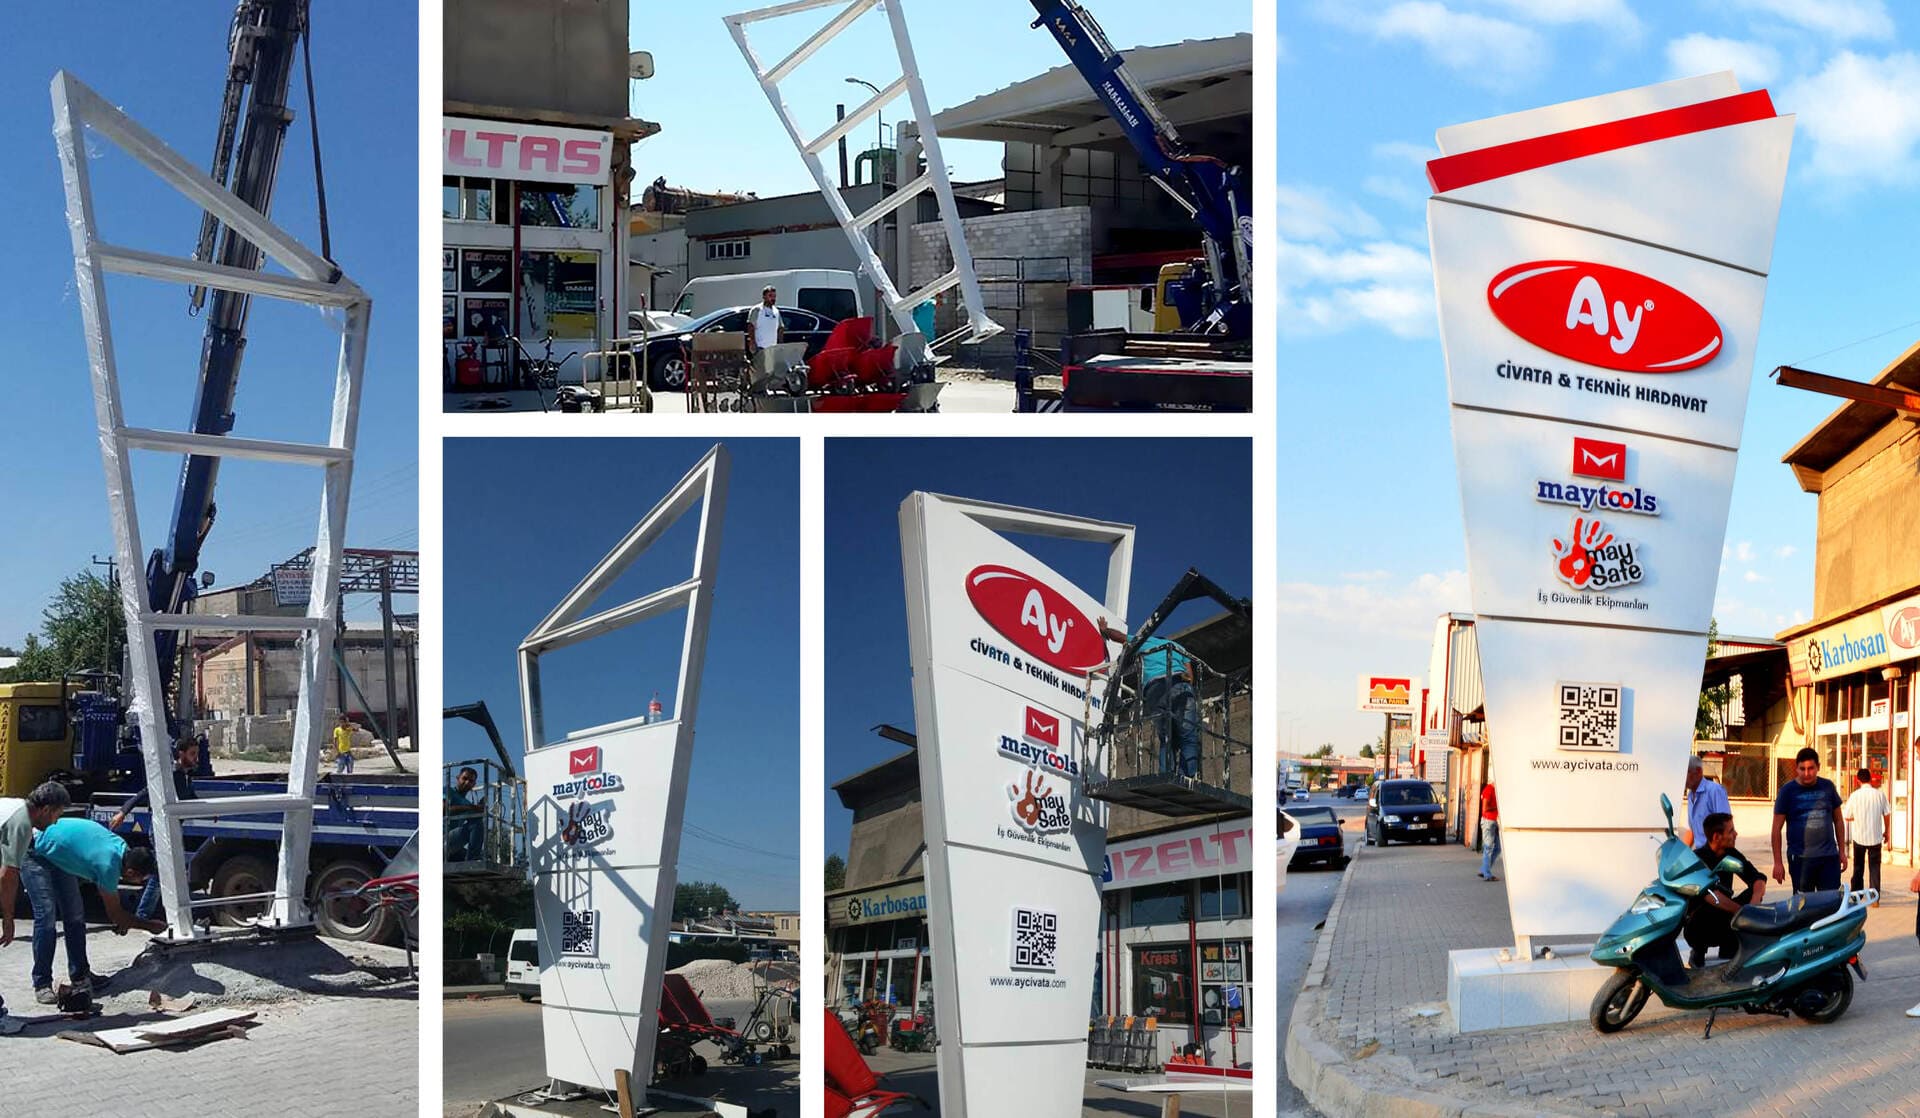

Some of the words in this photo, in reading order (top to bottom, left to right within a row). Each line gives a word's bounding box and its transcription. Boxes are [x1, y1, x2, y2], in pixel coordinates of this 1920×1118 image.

[443, 128, 602, 175] LTAS
[1566, 275, 1643, 354] Ay
[1497, 360, 1552, 385] CİVATA
[1558, 374, 1570, 388] &
[1577, 376, 1630, 399] TEKNİK
[1636, 386, 1708, 413] HIRDAVAT
[1537, 480, 1656, 512] maytools
[1585, 542, 1634, 566] may
[1591, 557, 1642, 586] Safe
[1552, 592, 1592, 605] Güvenlik
[1596, 595, 1649, 611] Ekipmanları
[1021, 588, 1067, 654] Ay
[1821, 632, 1886, 669] Karbosan
[970, 637, 1010, 665] CİVATA
[1013, 656, 1022, 671] &
[1025, 662, 1059, 688] TEKNİK
[1061, 680, 1101, 709] HIRDAAT
[1001, 735, 1079, 775] maytools
[1532, 759, 1639, 772] www.aycivata.com
[553, 773, 616, 795] maytools
[1034, 795, 1065, 815] may
[1039, 808, 1070, 828] Safe
[1112, 827, 1252, 881] IZELT
[862, 894, 927, 918] Karbosan
[1141, 950, 1178, 965] Kress
[990, 977, 1067, 989] www.aycivata.com
